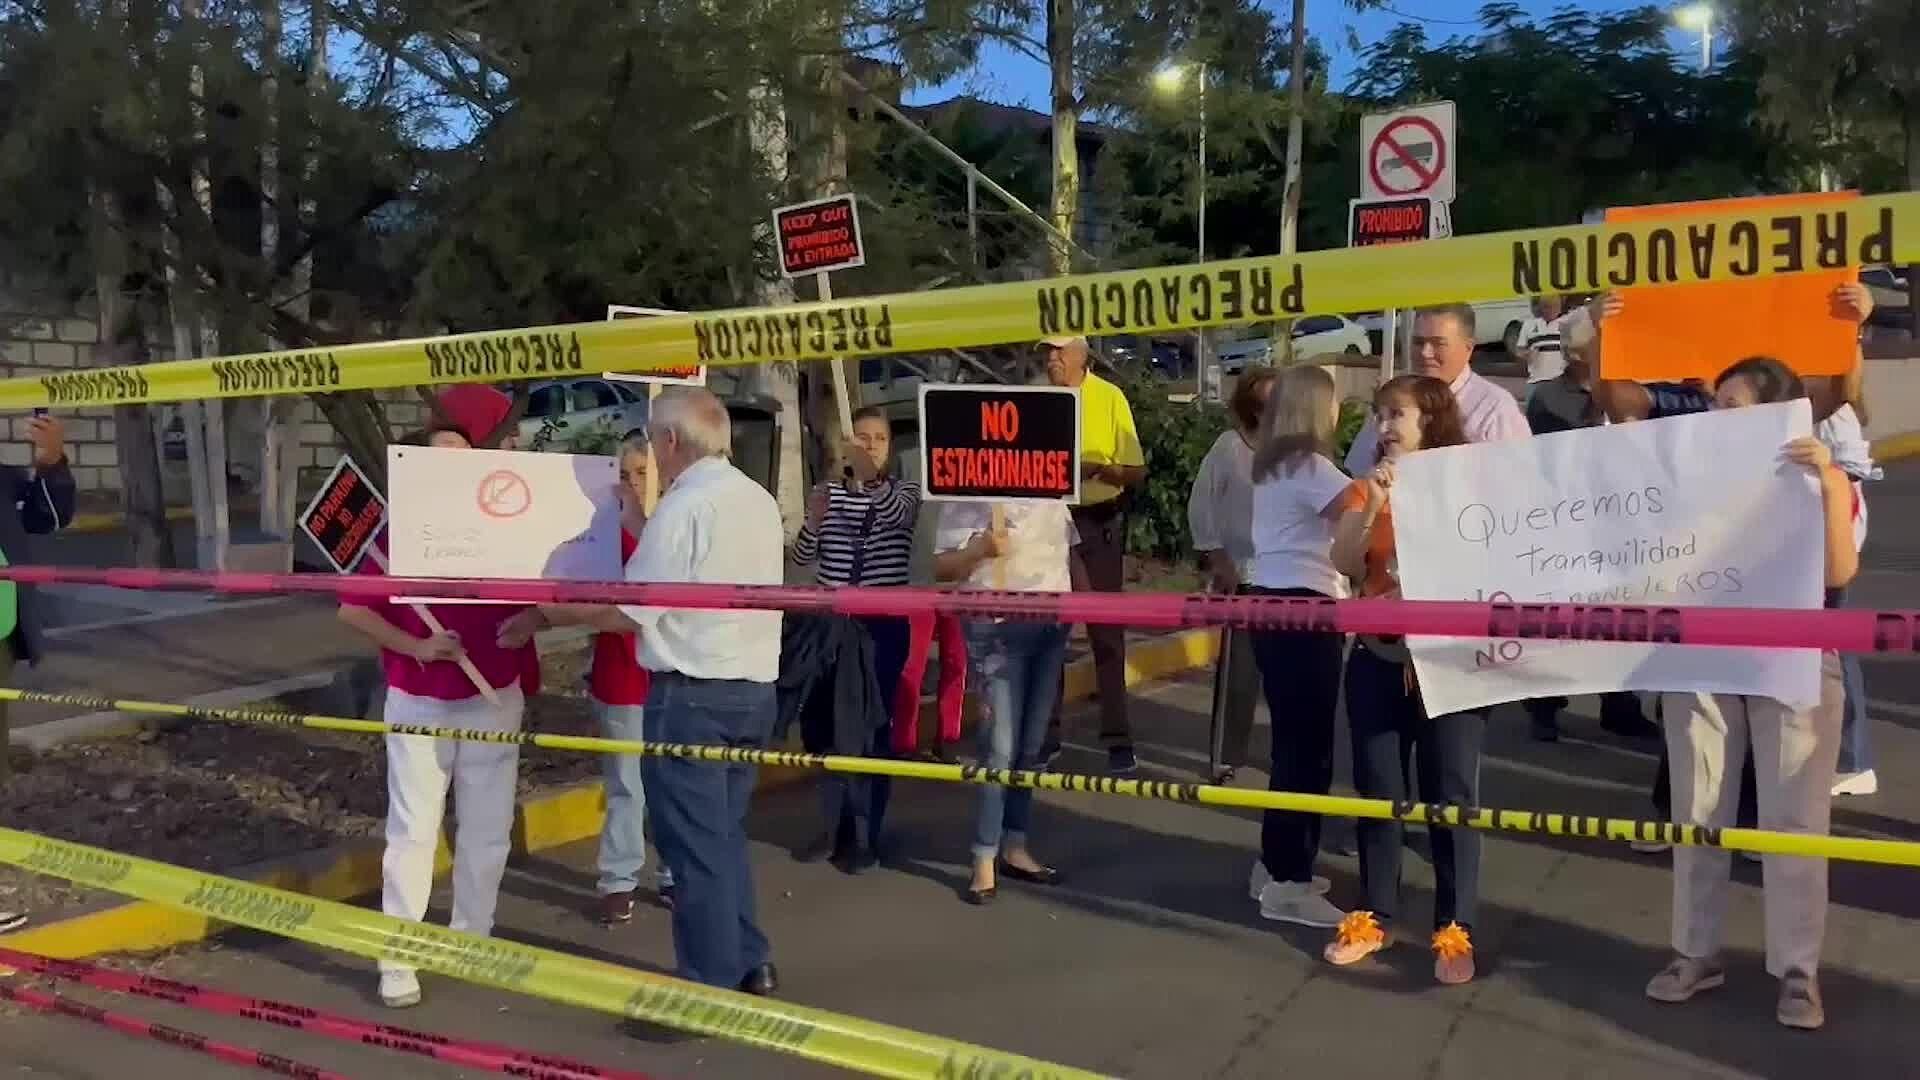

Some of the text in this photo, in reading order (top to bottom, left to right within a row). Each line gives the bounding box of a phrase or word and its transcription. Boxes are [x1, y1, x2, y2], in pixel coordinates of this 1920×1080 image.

[822, 206, 848, 223] OUT
[1359, 205, 1423, 233] PROHIBIDO
[1512, 208, 1893, 295] PRECAUCION
[1037, 264, 1305, 335] PRECAUCION
[694, 304, 892, 360] PRECAUCION
[425, 331, 582, 378] PRECAUCION
[981, 400, 1019, 441] NO
[932, 448, 1071, 489] ESTACIONARSE
[1457, 486, 1664, 548] Queremos
[1516, 534, 1697, 576] tranquilidad
[1475, 640, 1523, 666] NO
